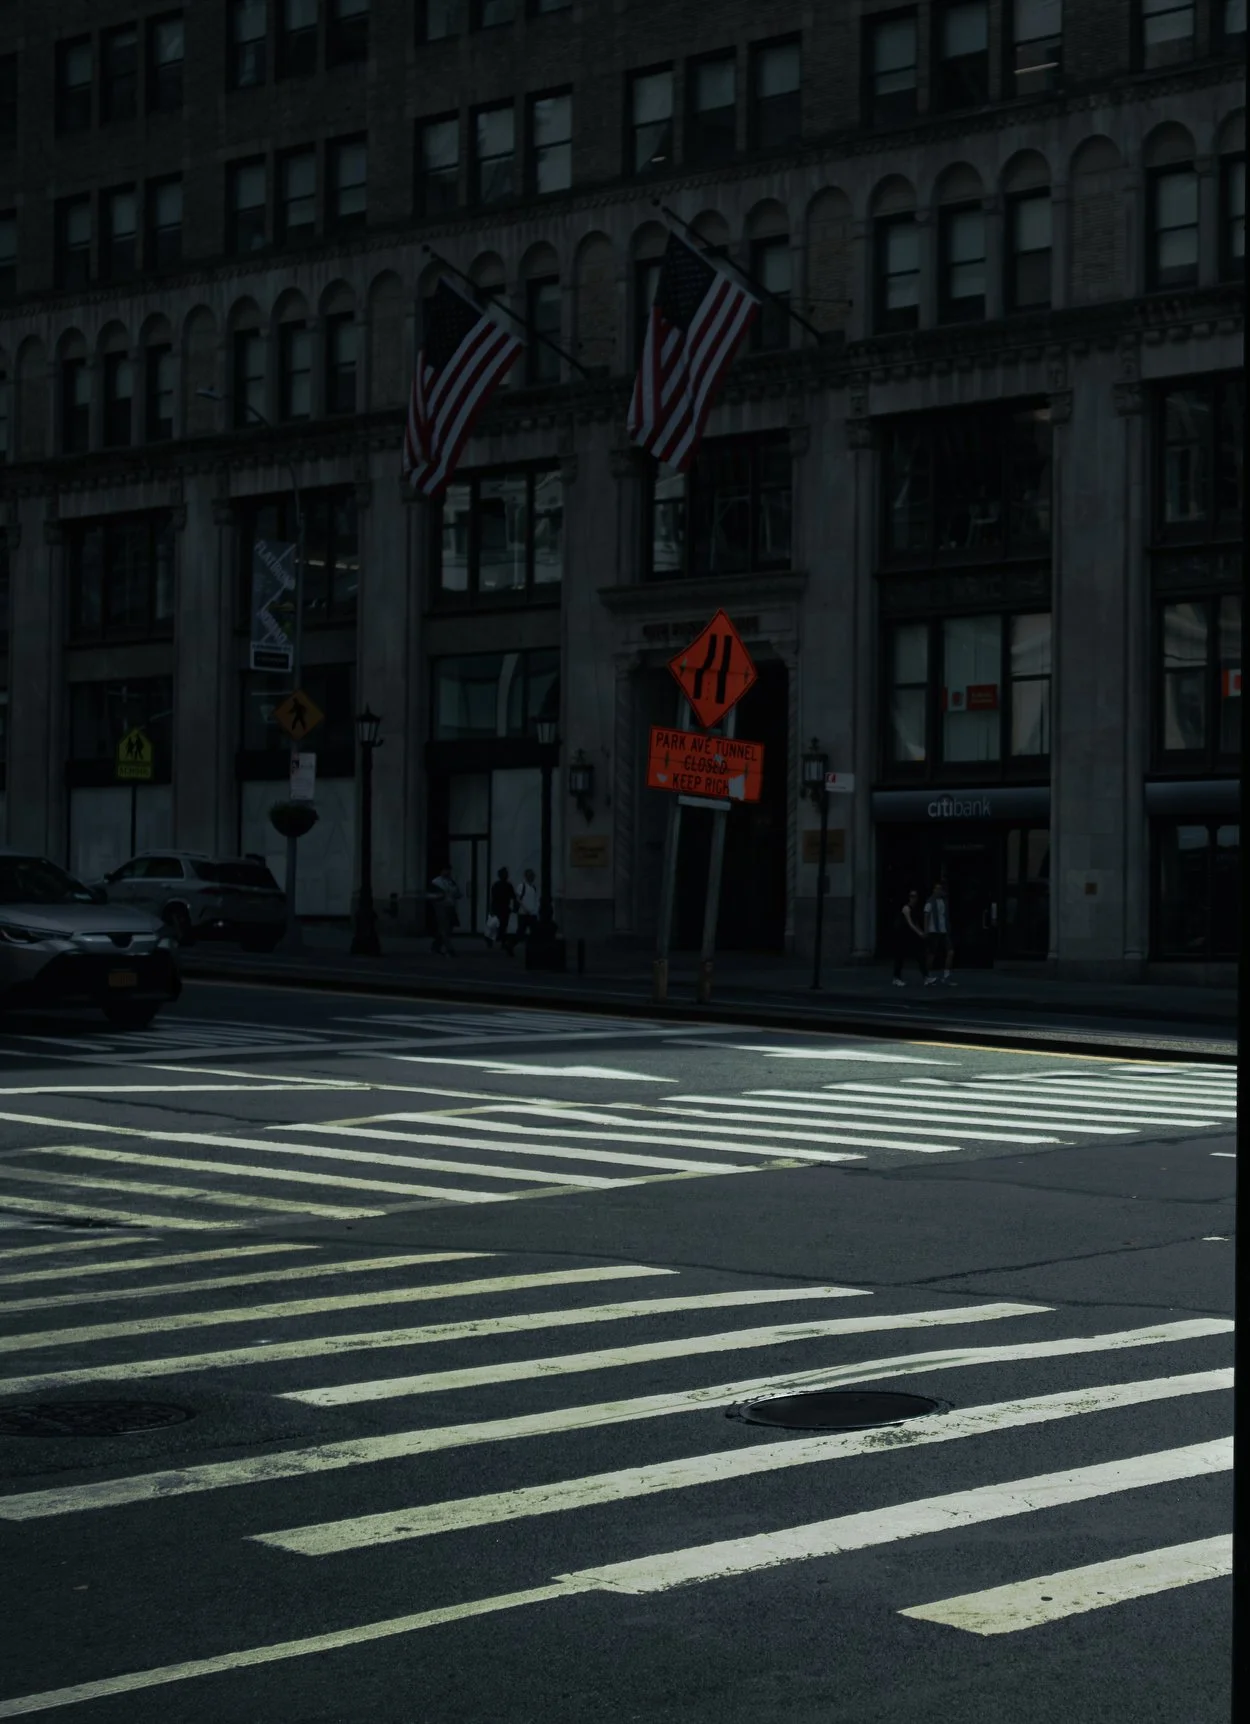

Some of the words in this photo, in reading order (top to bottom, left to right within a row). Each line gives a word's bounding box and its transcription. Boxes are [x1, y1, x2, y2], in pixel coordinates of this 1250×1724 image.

[656, 732, 686, 750] PARK
[691, 738, 711, 754] AVE
[716, 740, 757, 761] TUNNEL
[684, 755, 728, 775] CLOSED
[672, 773, 702, 790] KEEP
[705, 777, 730, 794] RIGH
[927, 795, 991, 817] citibank
